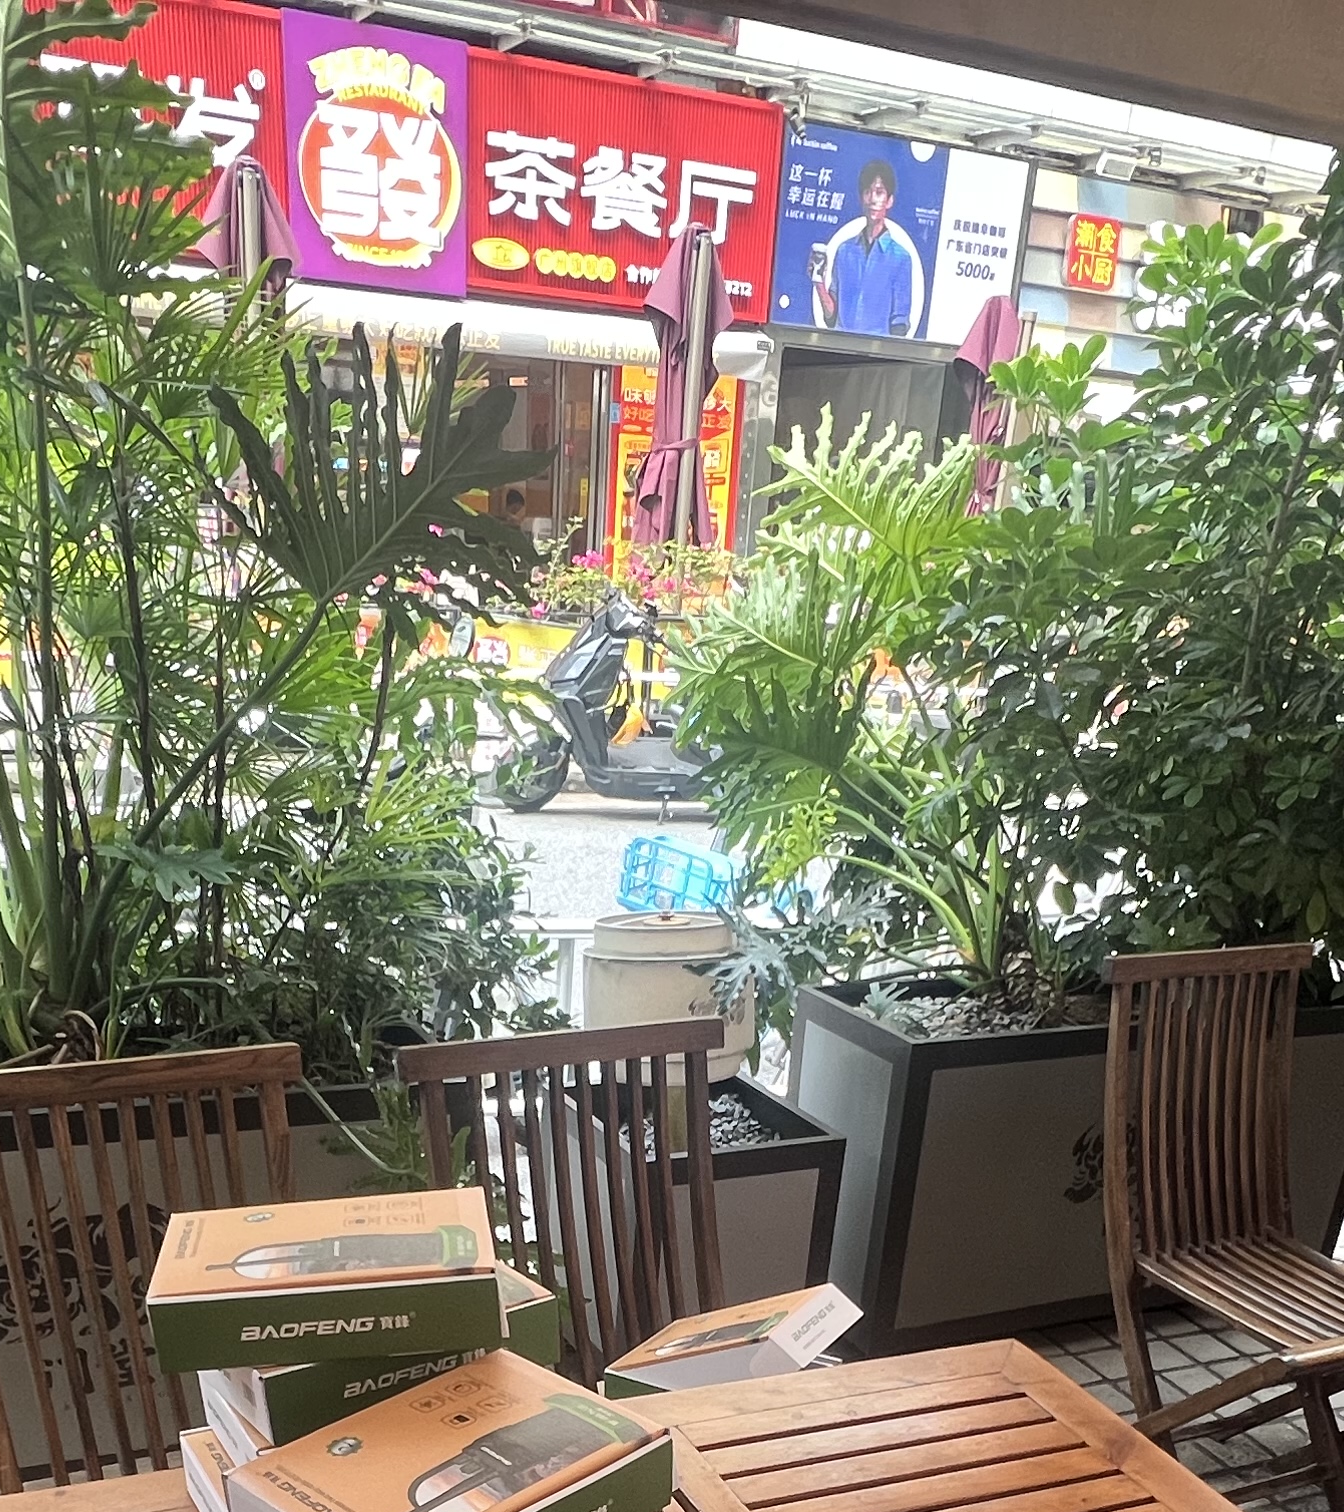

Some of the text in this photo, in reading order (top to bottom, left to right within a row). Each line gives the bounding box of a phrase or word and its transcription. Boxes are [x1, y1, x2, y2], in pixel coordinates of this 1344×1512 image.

[484, 130, 757, 246] 茶餐厅
[788, 163, 833, 187] 这一杯
[787, 185, 845, 212] 幸运在握
[239, 1316, 375, 1342] BAOFENG
[343, 1354, 458, 1399] BAOFENG
